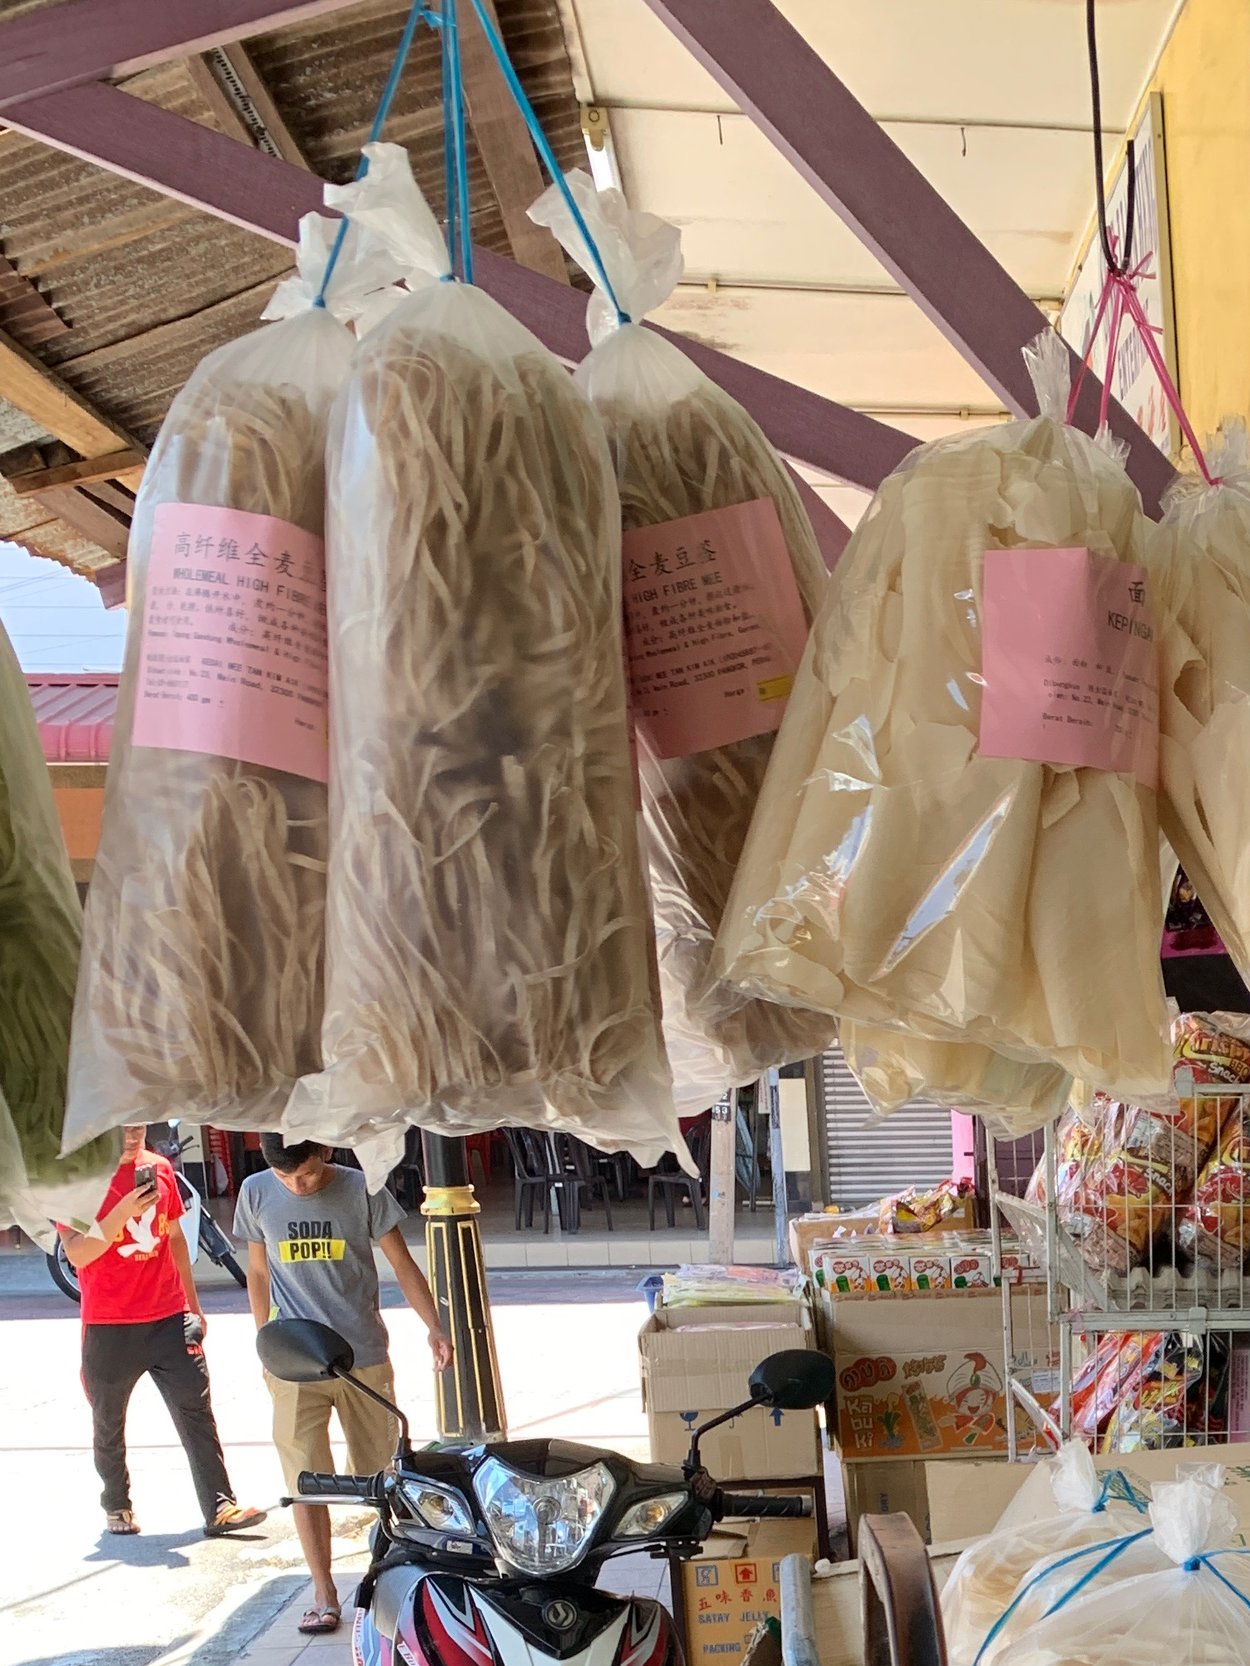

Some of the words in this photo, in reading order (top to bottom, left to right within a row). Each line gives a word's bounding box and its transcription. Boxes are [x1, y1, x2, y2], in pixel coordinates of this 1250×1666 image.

[174, 531, 327, 592] 高纤维全麦
[173, 567, 229, 586] WHOLEMEAL
[236, 575, 270, 593] HIGH
[663, 577, 698, 597] FIBRE
[287, 1220, 333, 1240] SODA
[289, 1241, 333, 1261] POP!!
[697, 1612, 730, 1625] SATAY
[739, 1610, 769, 1622] JELLY
